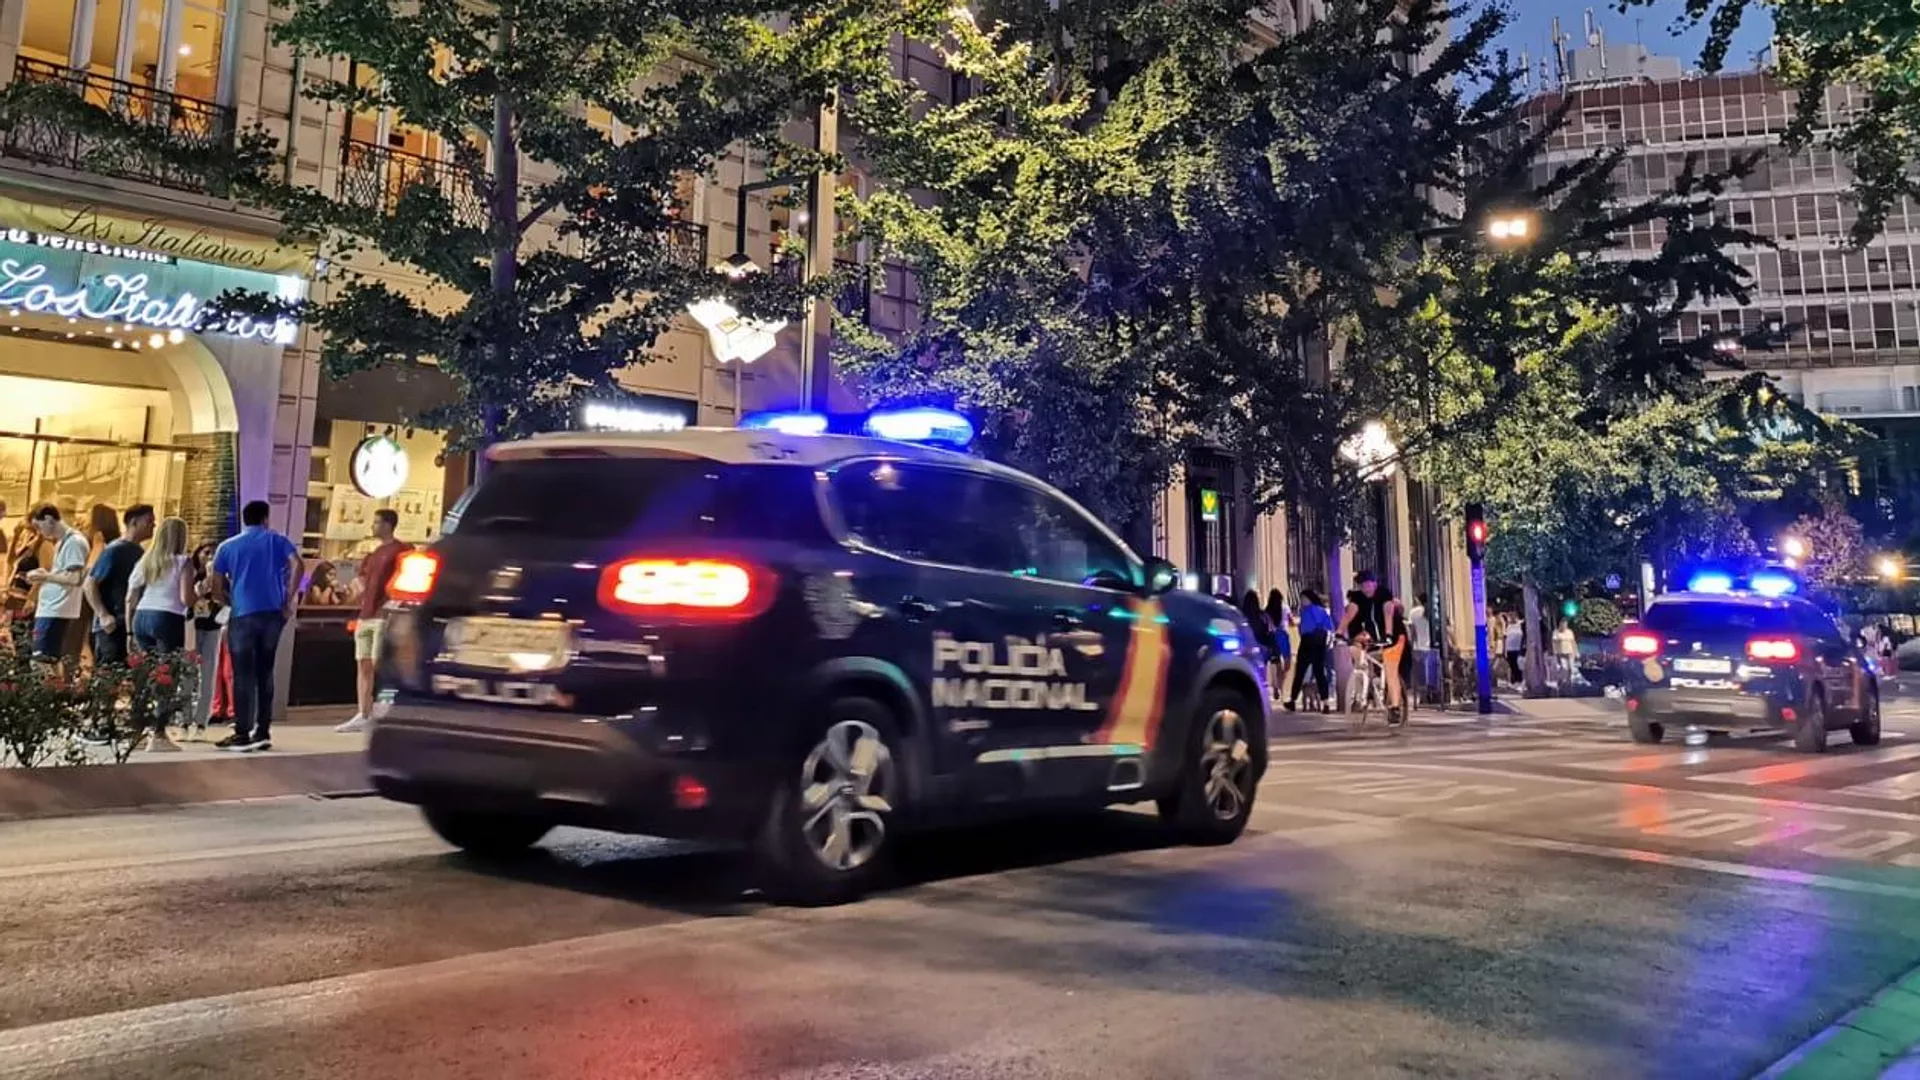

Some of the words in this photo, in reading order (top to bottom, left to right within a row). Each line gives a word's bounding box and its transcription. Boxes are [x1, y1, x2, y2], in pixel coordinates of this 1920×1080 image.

[53, 203, 112, 240] Los
[118, 216, 266, 267] Italianos
[931, 677, 1099, 711] NACIONAL
